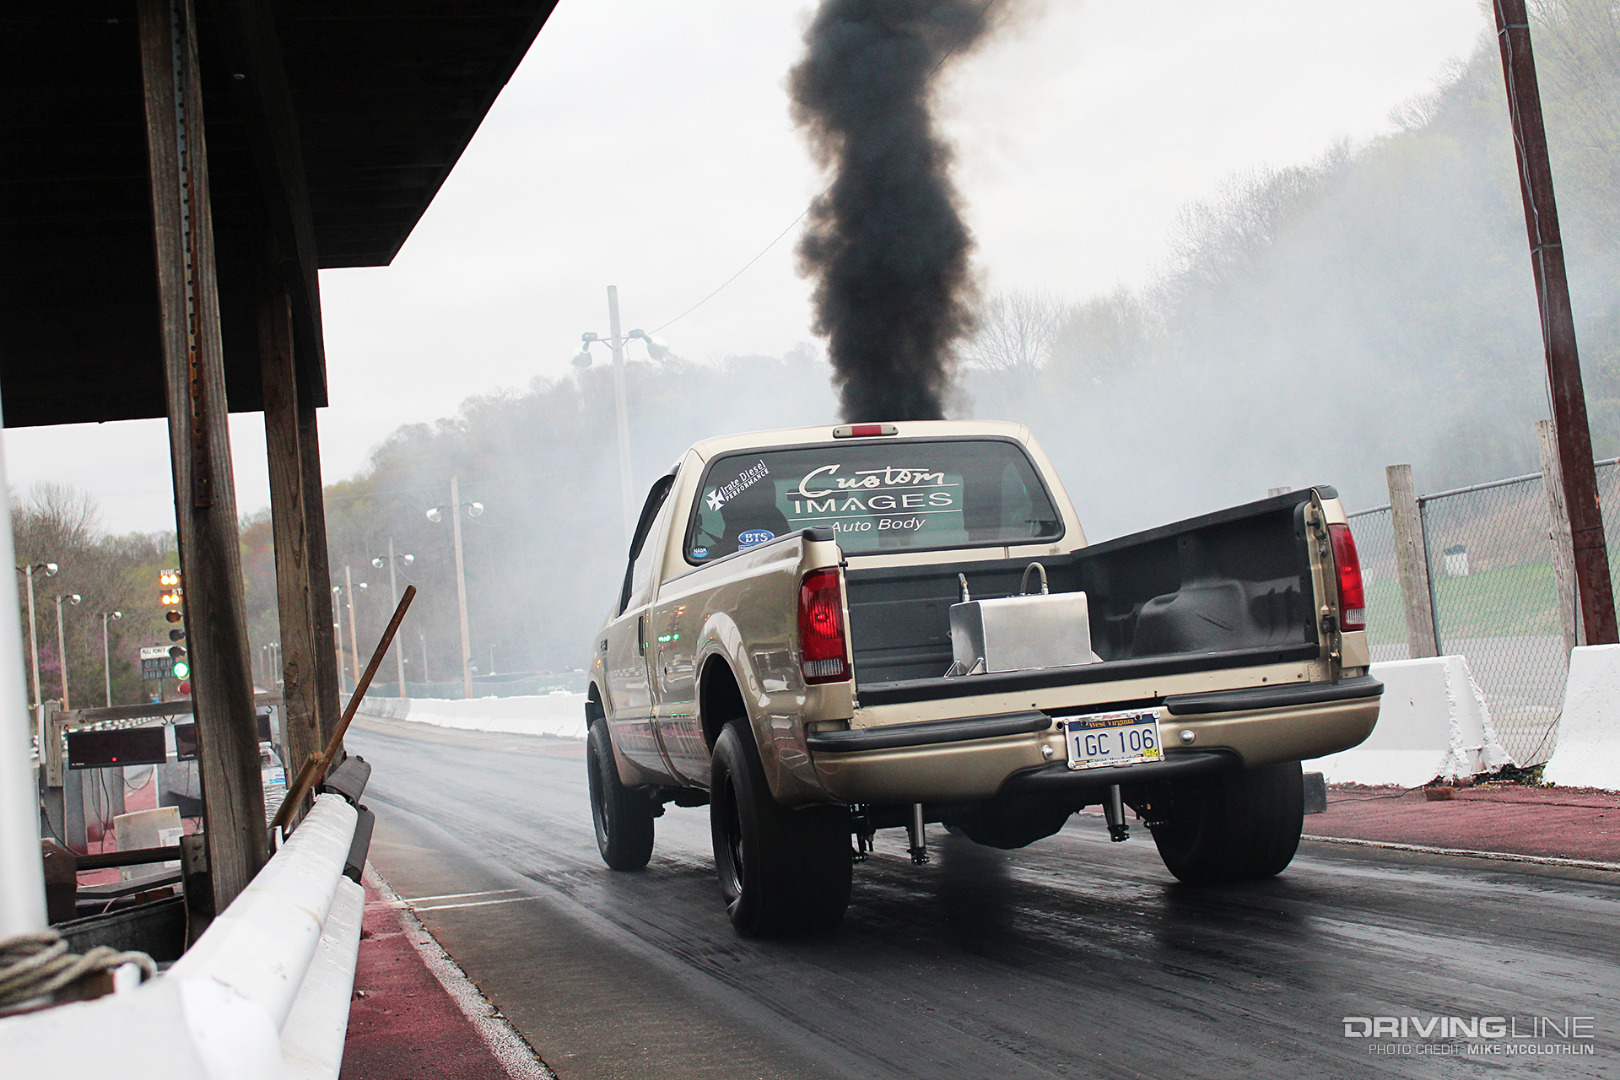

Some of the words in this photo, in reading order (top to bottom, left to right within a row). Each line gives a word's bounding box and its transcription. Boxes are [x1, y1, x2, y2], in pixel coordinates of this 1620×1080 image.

[720, 479, 740, 495] Irate
[739, 459, 767, 482] Diesel
[725, 468, 770, 502] PERFORMANCE
[799, 464, 945, 498] Custom
[794, 492, 953, 514] IMAGES
[744, 532, 769, 543] BTS
[832, 521, 871, 533] Auto
[878, 517, 927, 531] Body
[1107, 719, 1134, 727] Virginia
[1075, 733, 1110, 758] 1GC
[1119, 729, 1154, 753] 106
